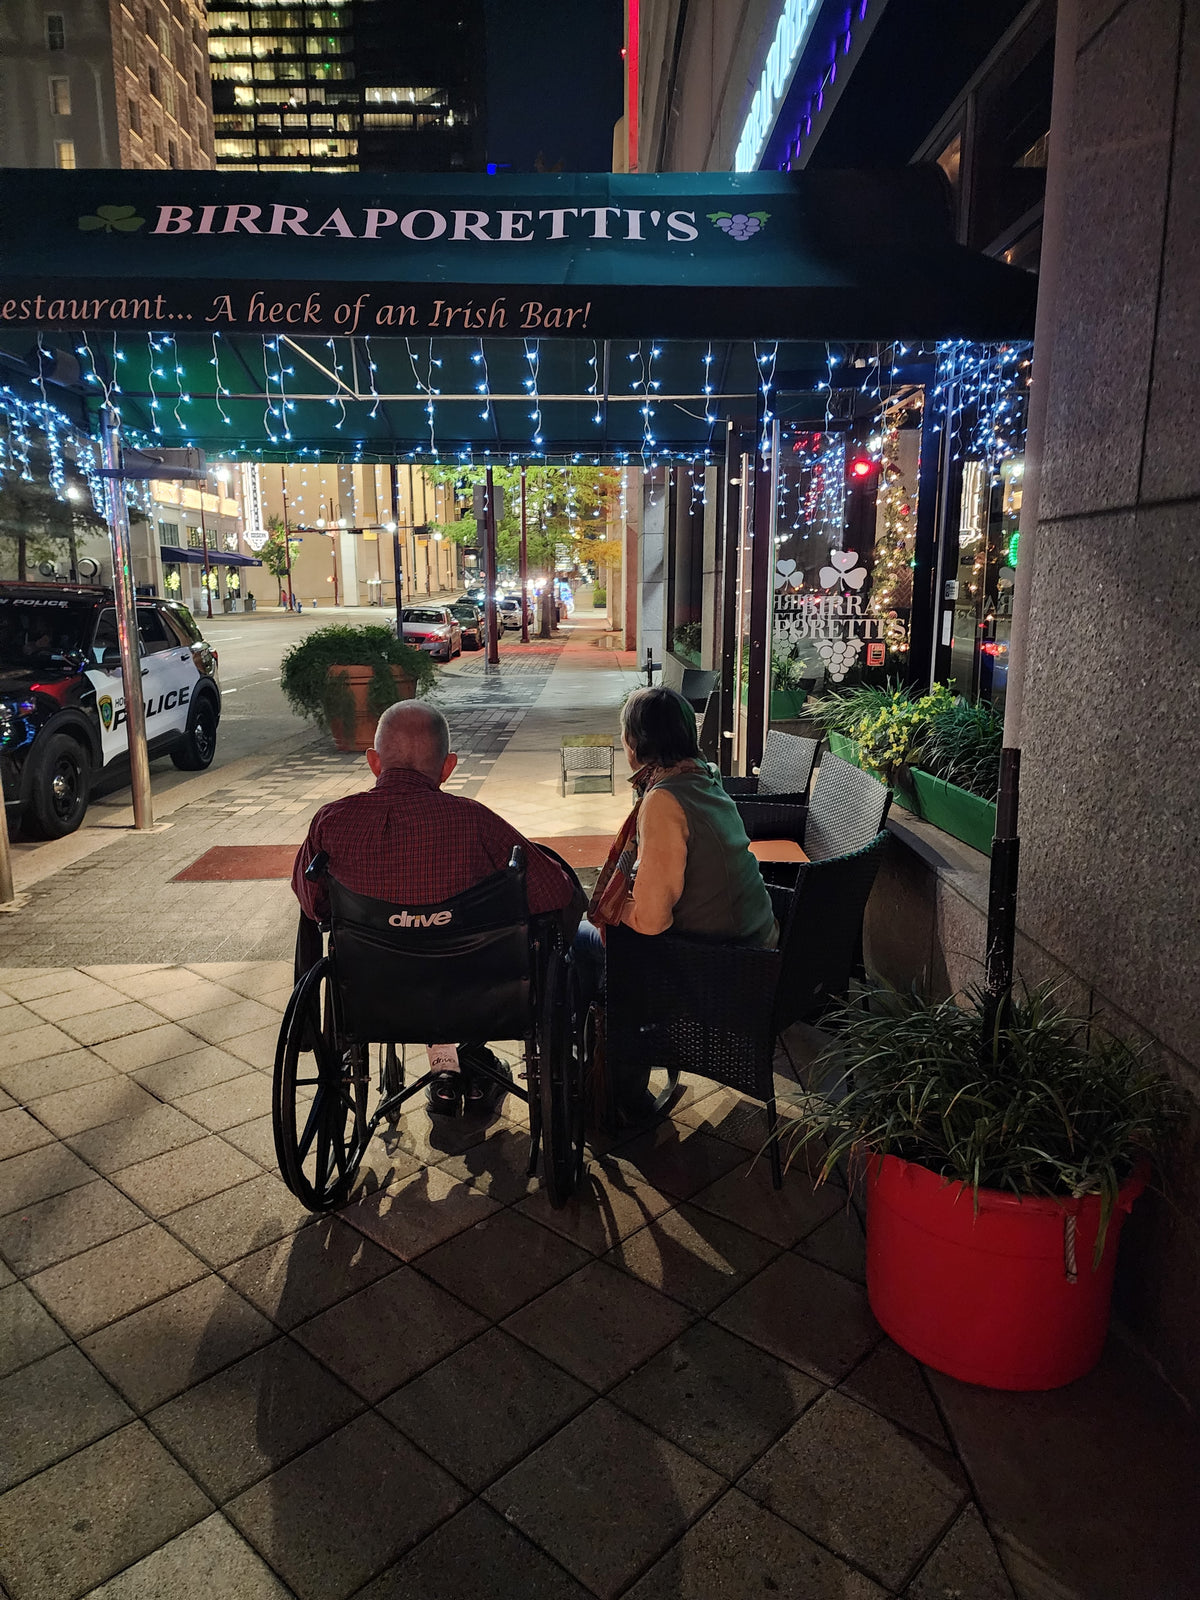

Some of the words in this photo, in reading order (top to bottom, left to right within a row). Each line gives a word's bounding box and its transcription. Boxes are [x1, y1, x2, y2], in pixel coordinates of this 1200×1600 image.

[149, 203, 699, 242] BIRRAPORETTI'S
[0, 294, 193, 321] estaurant...
[205, 294, 237, 322] A
[247, 291, 323, 324] heck
[333, 293, 371, 335] of
[375, 301, 420, 327] an
[427, 296, 509, 330] Irish
[519, 301, 592, 329] Bar!
[12, 599, 69, 607] POLICE
[112, 686, 190, 731] PLICE
[388, 910, 453, 928] drive
